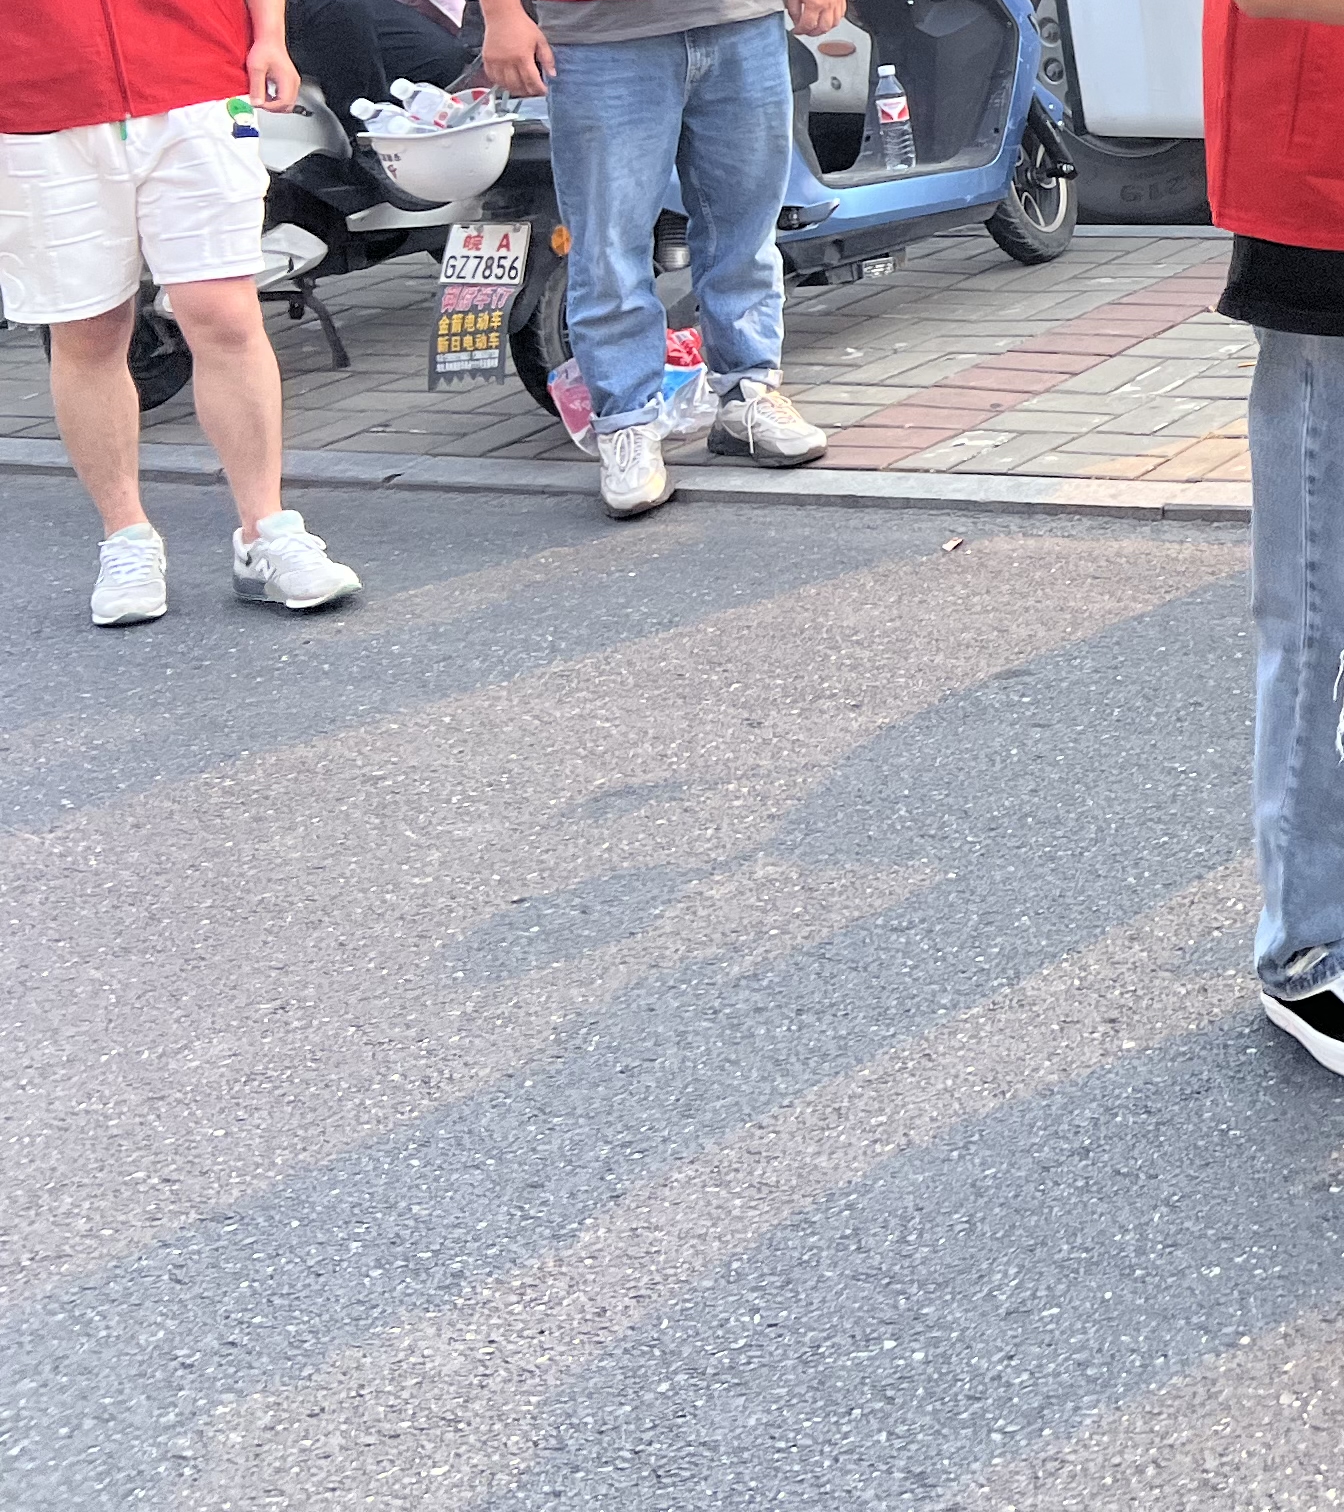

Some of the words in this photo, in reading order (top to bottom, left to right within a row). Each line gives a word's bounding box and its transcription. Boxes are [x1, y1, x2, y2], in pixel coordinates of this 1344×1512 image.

[463, 233, 484, 251] 皖
[496, 233, 512, 252] A
[443, 255, 520, 280] GZ7856
[436, 332, 501, 353] 新日电动车
